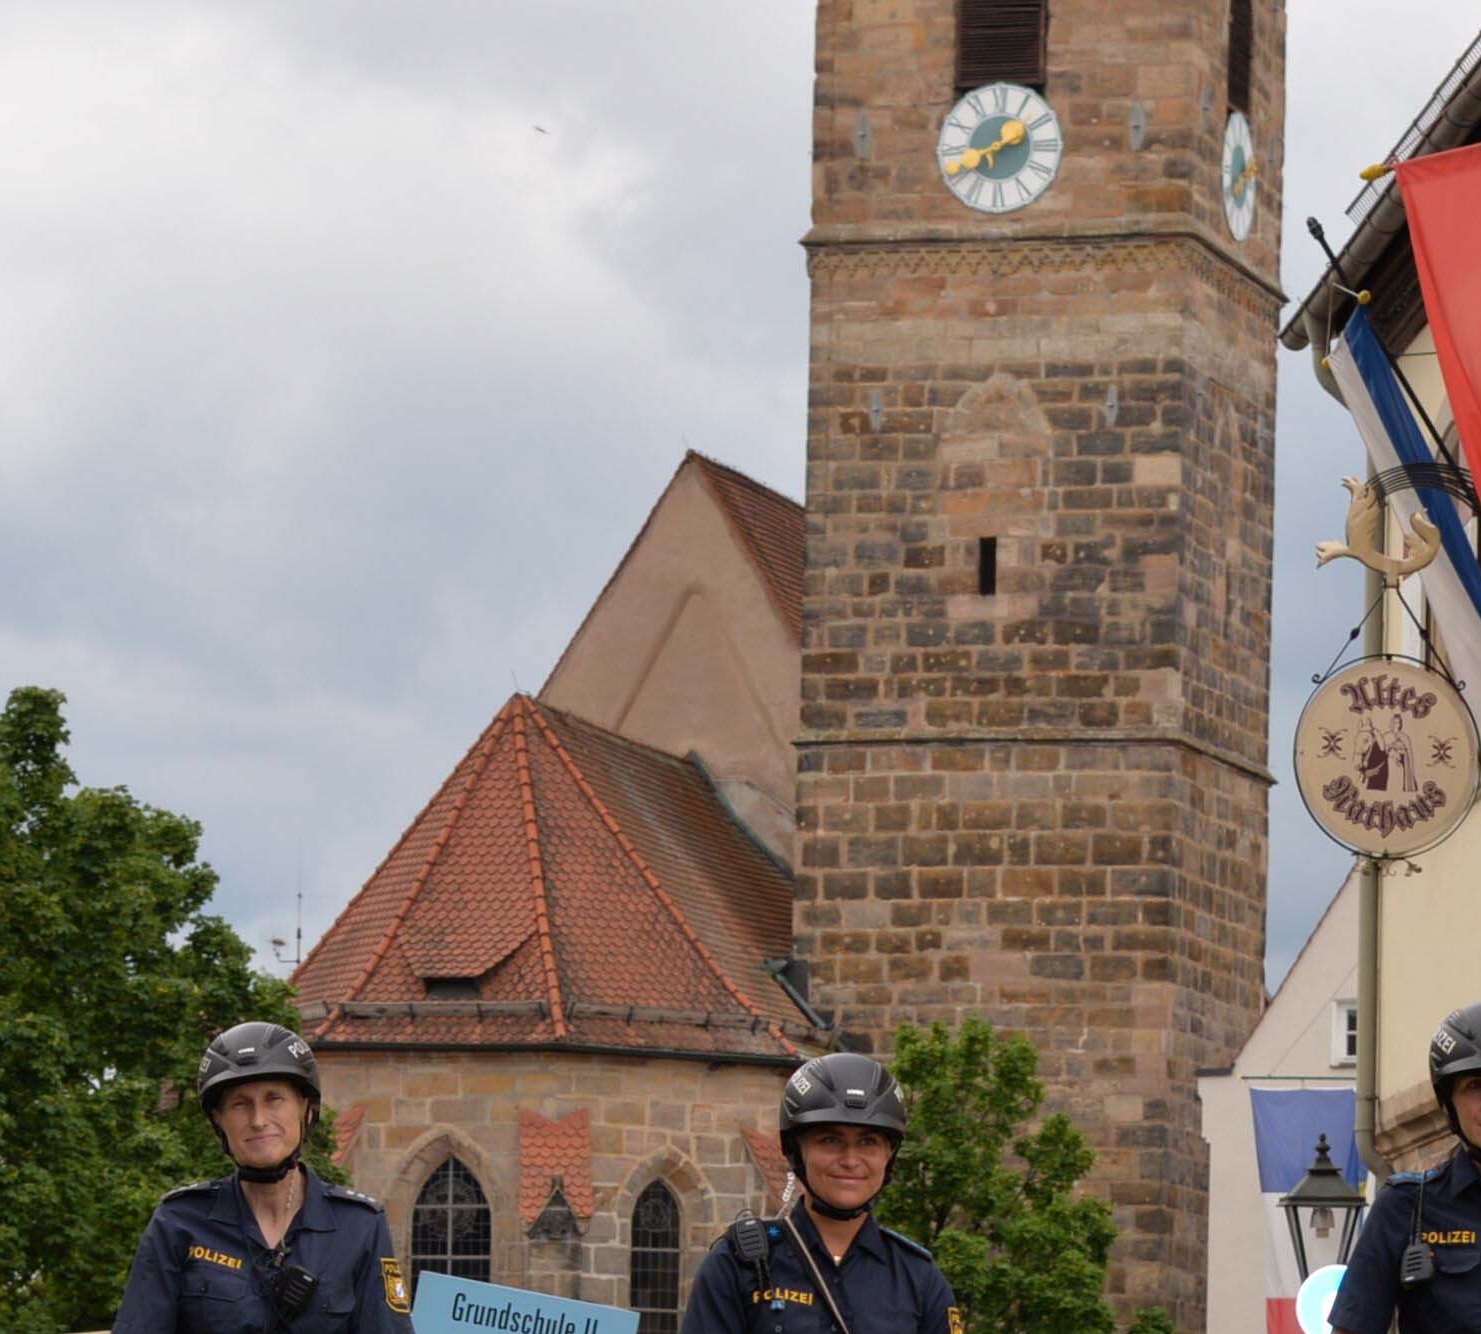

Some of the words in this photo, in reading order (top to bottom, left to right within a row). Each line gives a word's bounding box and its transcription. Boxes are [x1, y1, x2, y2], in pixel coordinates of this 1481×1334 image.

[1340, 674, 1437, 719] Altes
[1322, 775, 1447, 838] Rathaus
[1421, 1230, 1476, 1244] POLIZEI
